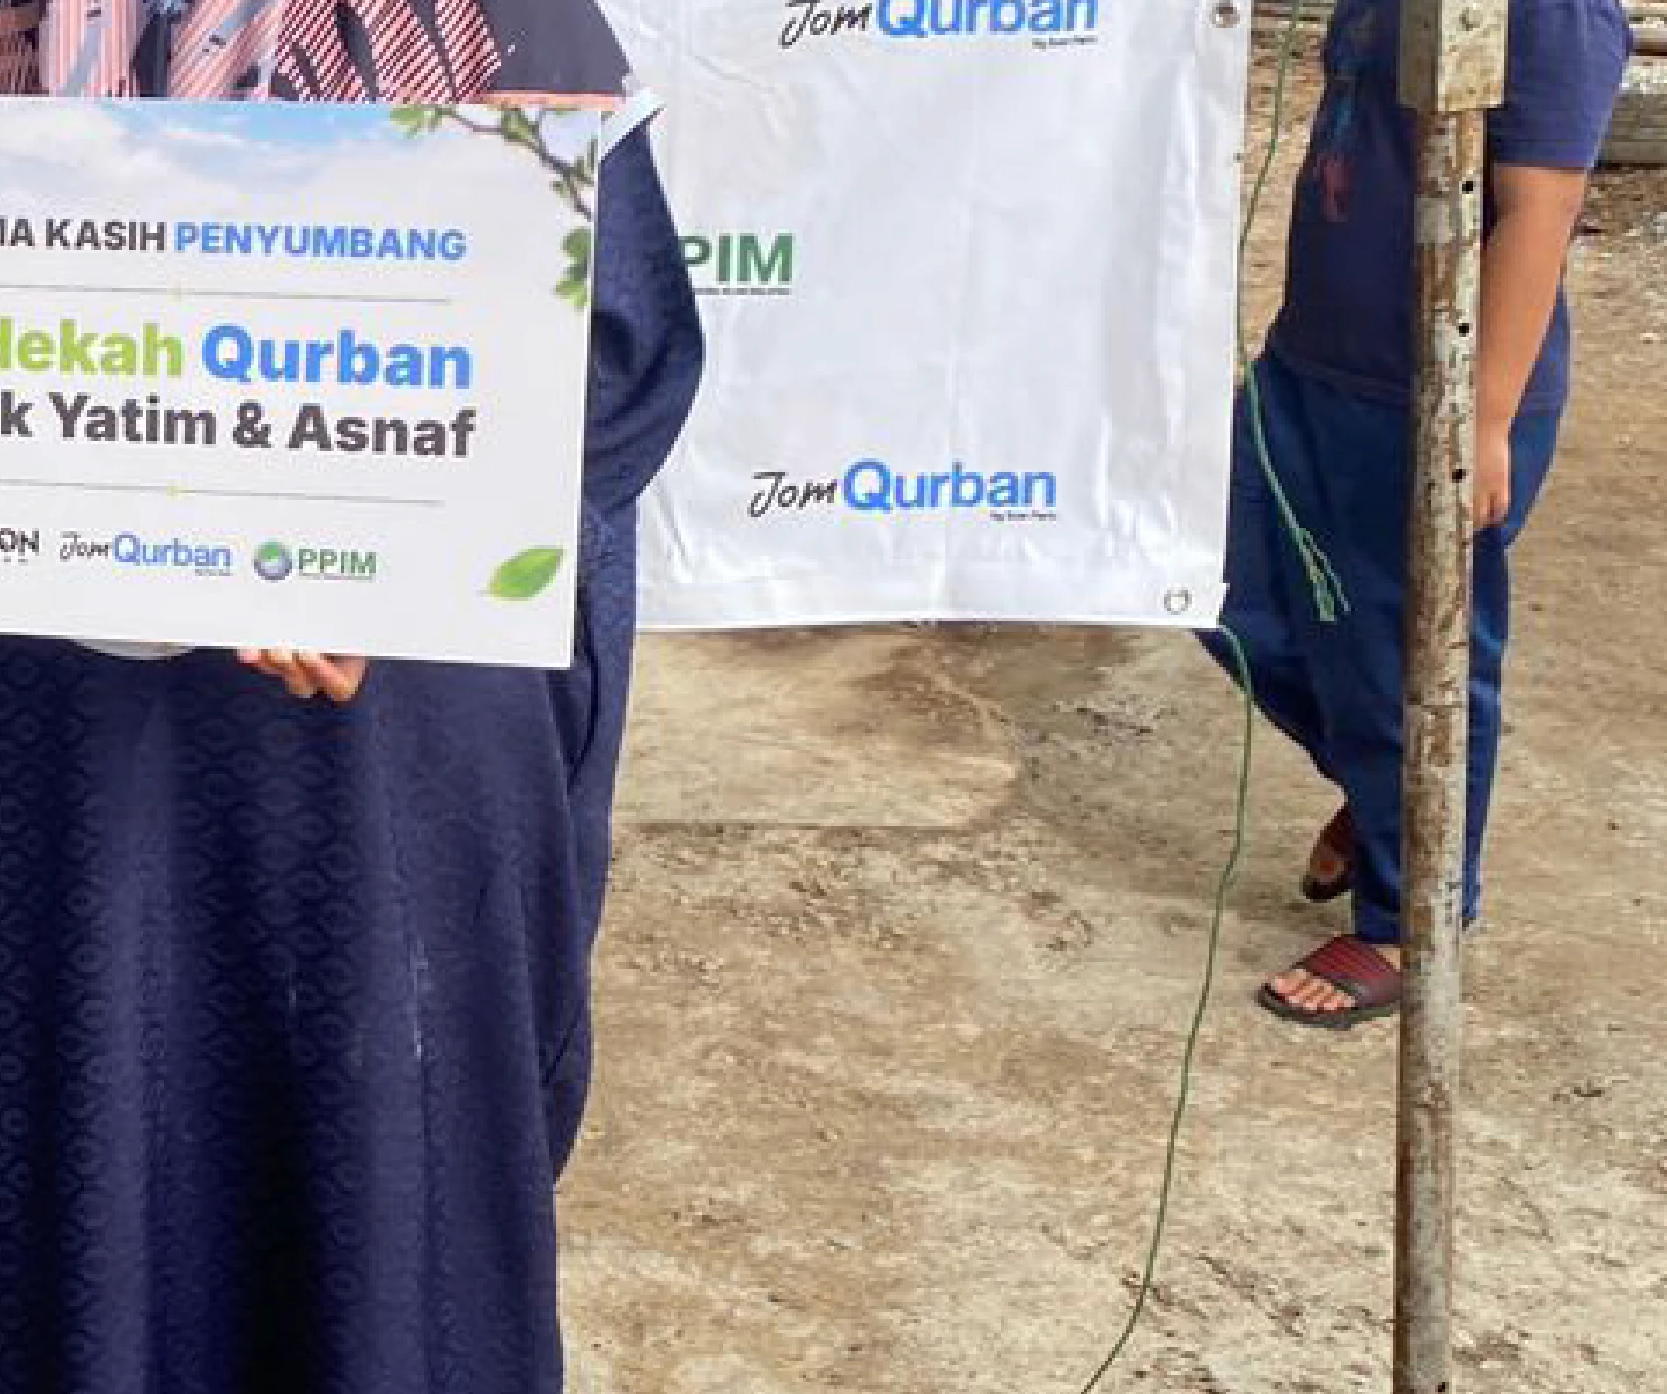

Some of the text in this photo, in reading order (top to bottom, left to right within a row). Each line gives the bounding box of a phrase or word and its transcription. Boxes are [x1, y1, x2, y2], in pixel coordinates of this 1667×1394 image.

[46, 219, 165, 251] KASIH
[174, 222, 467, 261] PENYUMBANG
[678, 233, 793, 283] PIM
[202, 325, 472, 388] Qurban
[49, 393, 216, 444] Yatim
[233, 403, 272, 448] &
[289, 405, 477, 457] Asnaf
[298, 548, 377, 575] PPIM
